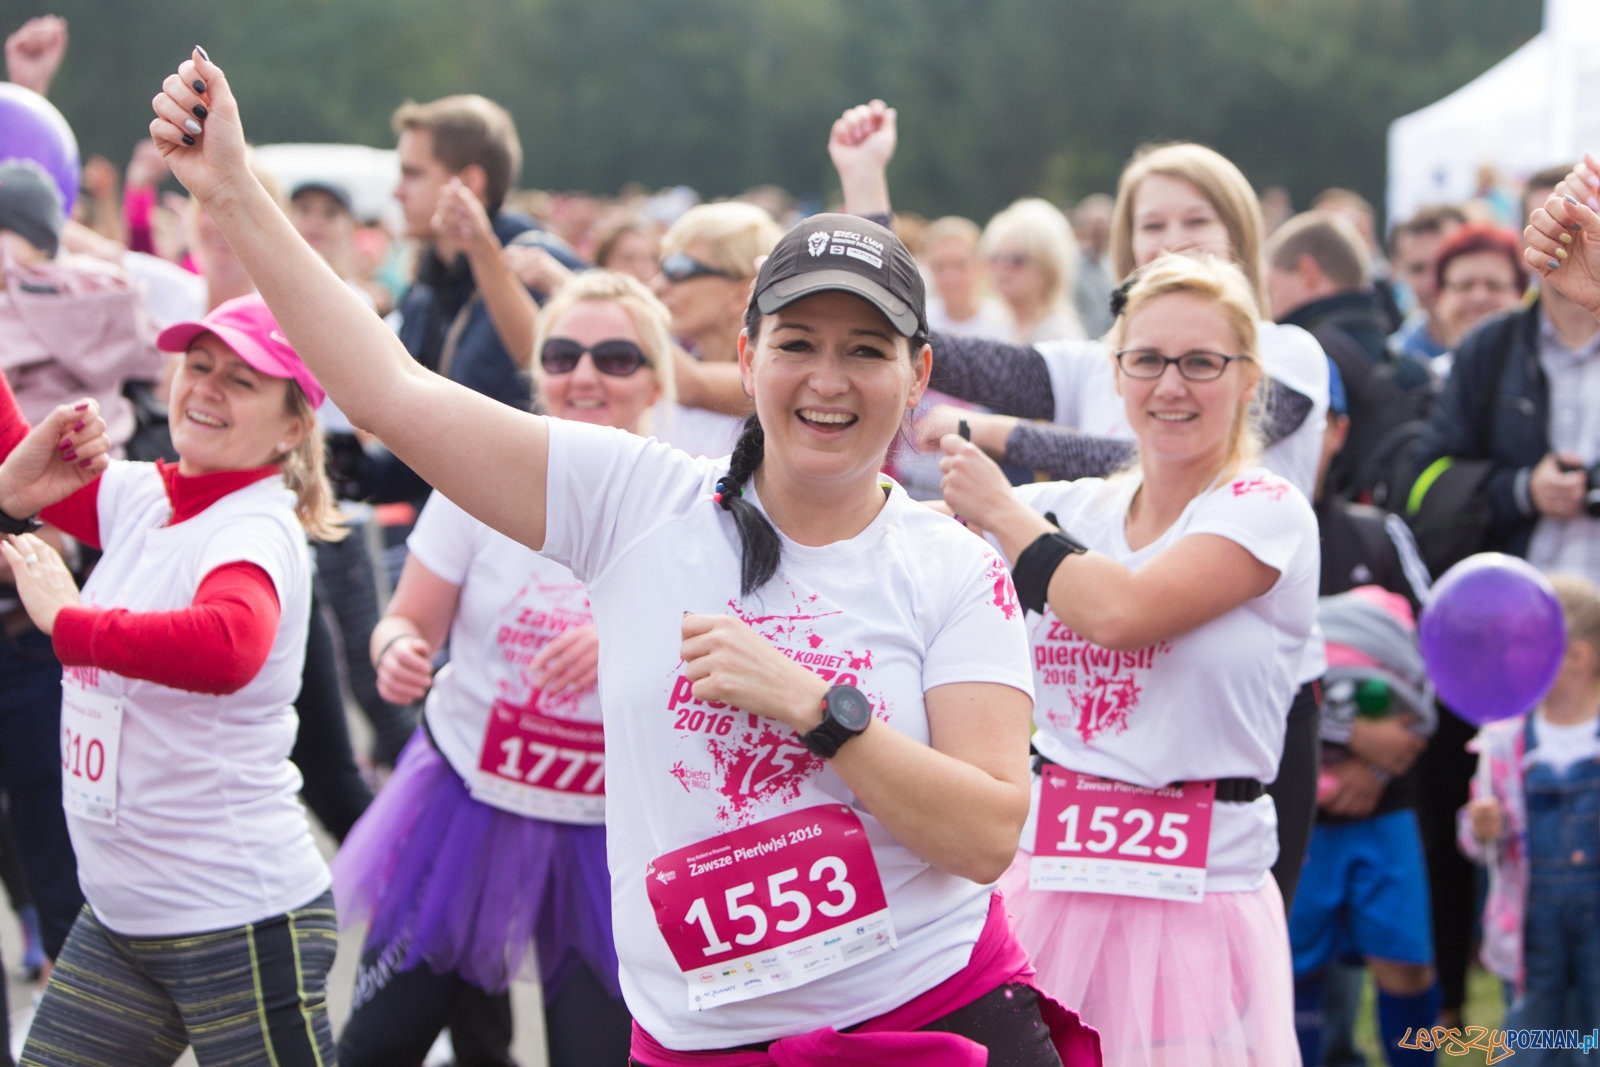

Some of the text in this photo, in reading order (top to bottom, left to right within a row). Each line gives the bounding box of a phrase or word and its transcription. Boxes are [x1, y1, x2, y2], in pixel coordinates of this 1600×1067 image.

[863, 236, 884, 252] LWA
[793, 650, 845, 669] KOBIET
[1043, 669, 1077, 685] 2016
[673, 708, 735, 736] 2016
[496, 735, 605, 794] 1777
[1076, 779, 1113, 792] Zawsze
[1056, 804, 1190, 860] 1525
[688, 855, 733, 877] Zawsze
[733, 834, 788, 862] Pier(w)si
[788, 823, 822, 845] 2016
[684, 855, 857, 957] 1553
